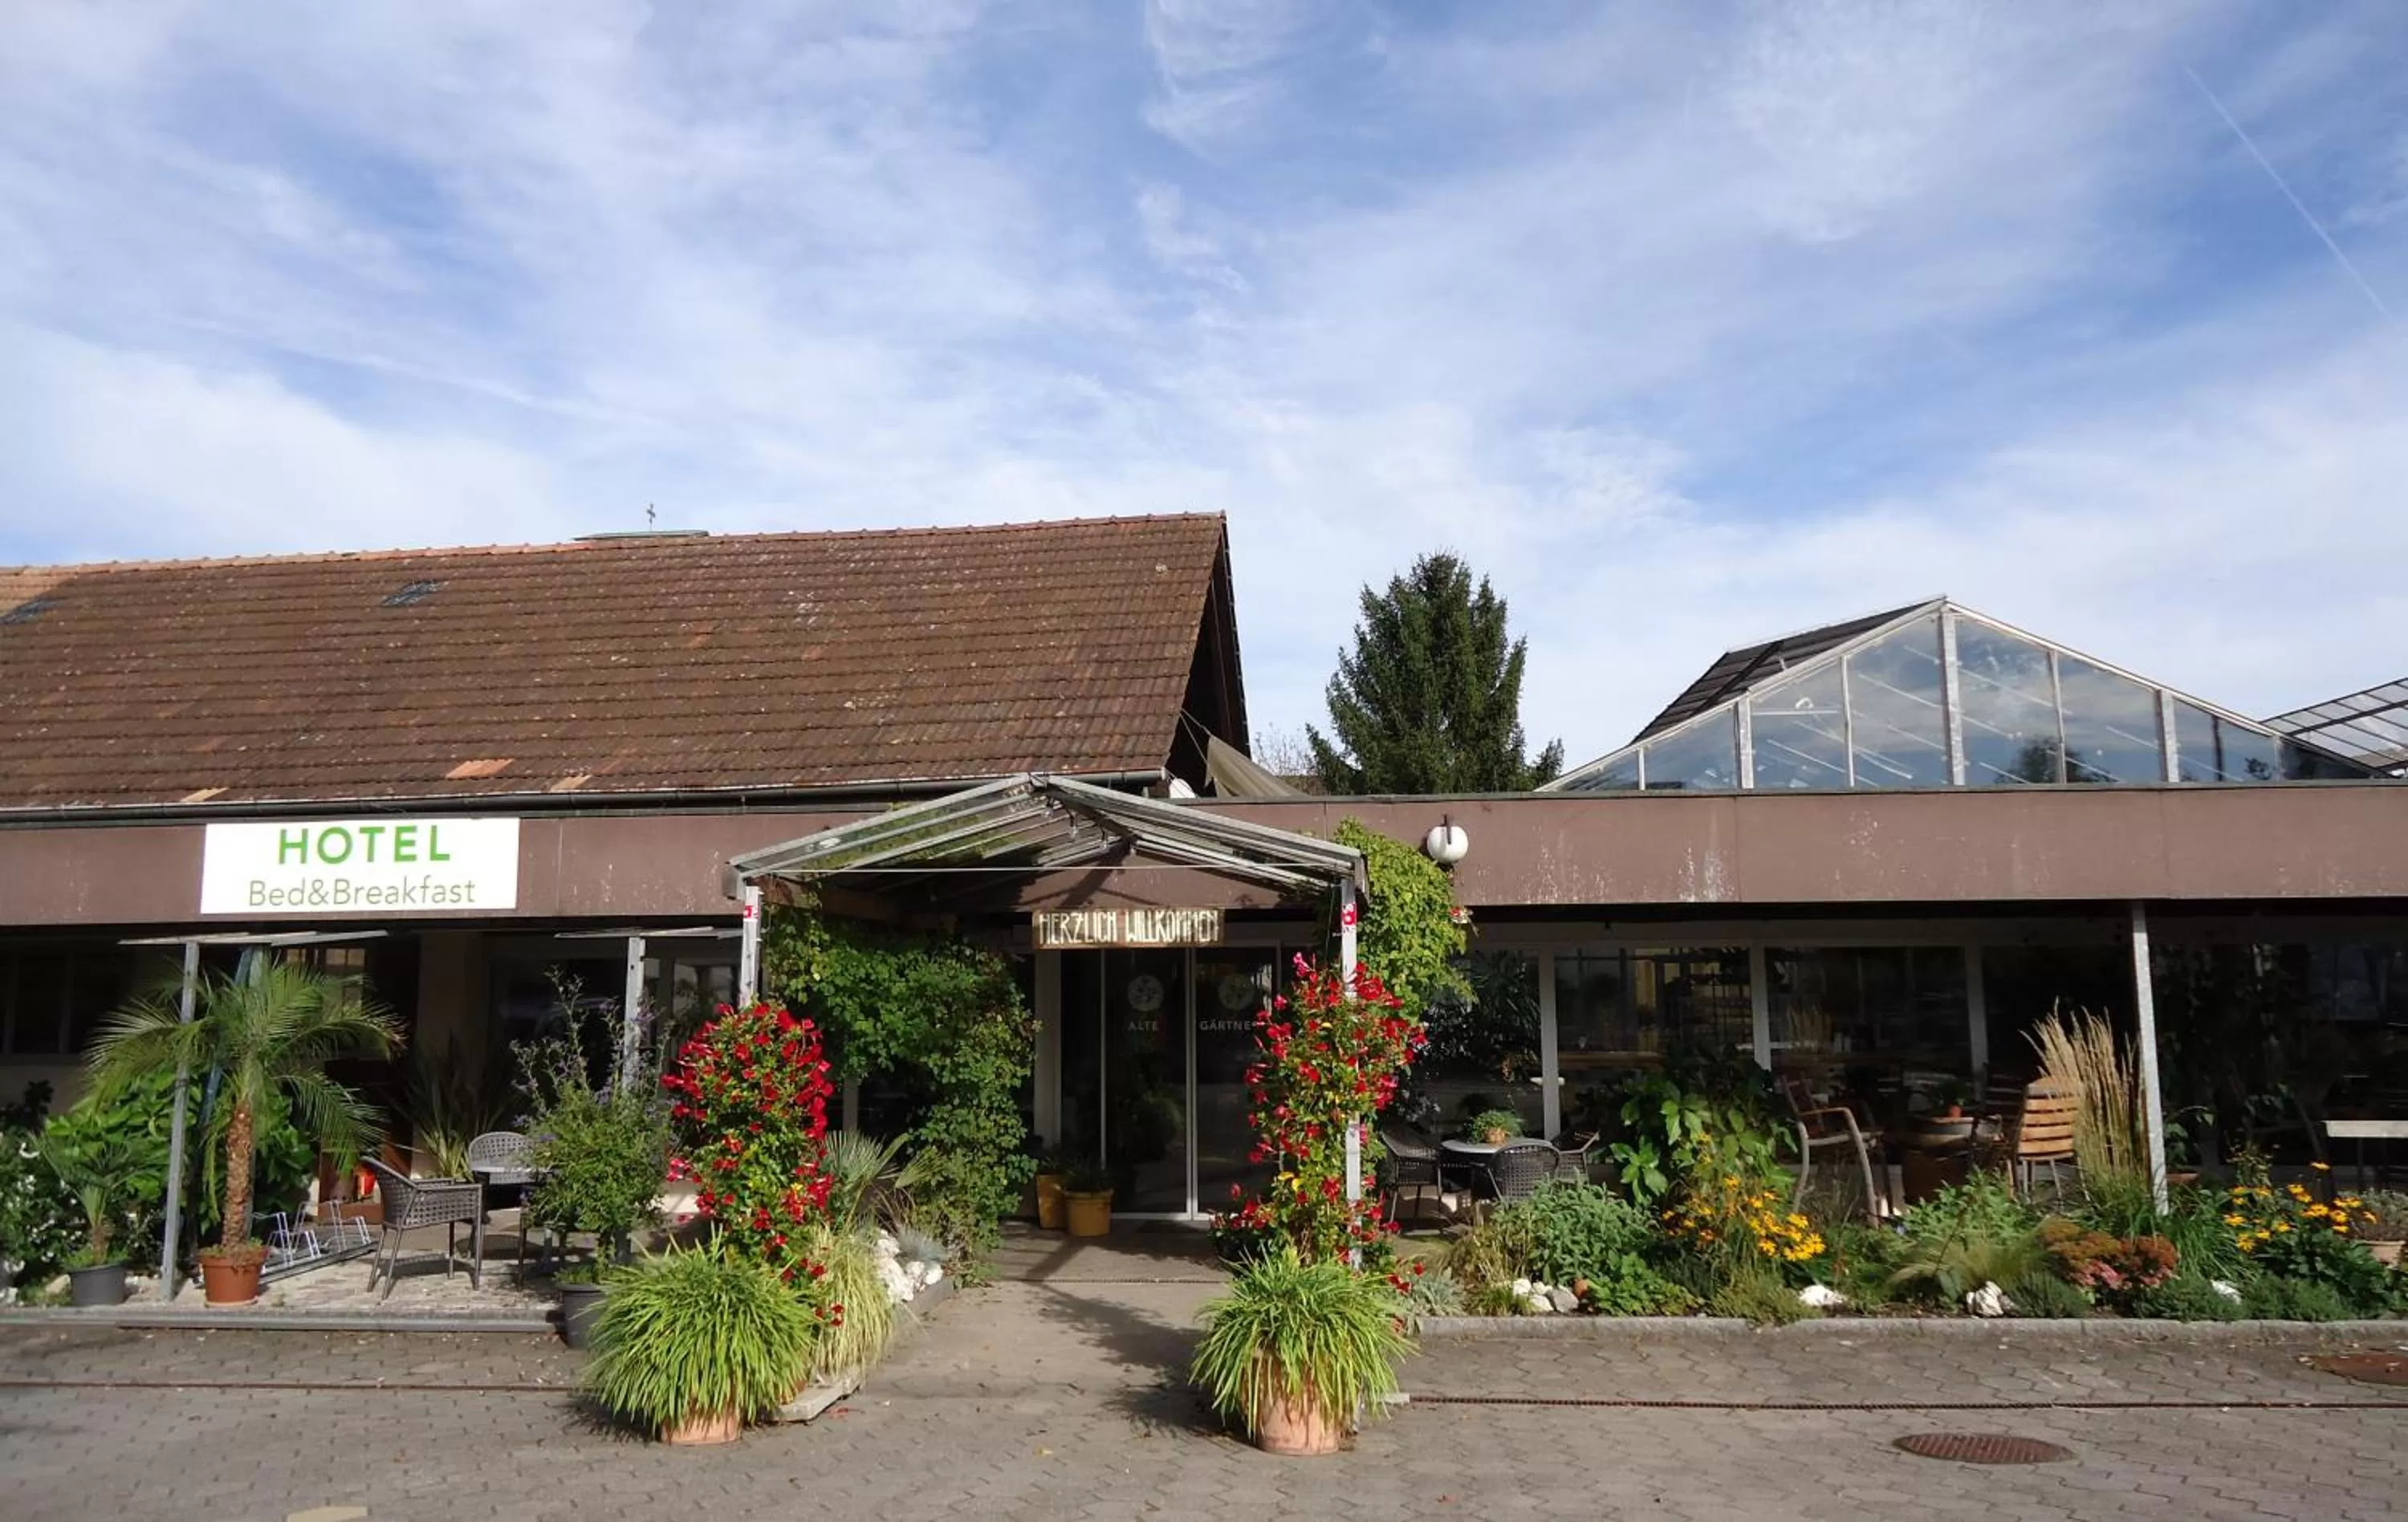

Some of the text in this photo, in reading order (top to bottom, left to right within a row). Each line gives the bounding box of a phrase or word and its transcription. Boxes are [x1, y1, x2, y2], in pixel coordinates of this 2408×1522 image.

[278, 824, 450, 865] HOTEL
[249, 876, 476, 907] Bed&Breakfast
[1039, 908, 1219, 945] HERZLICH WILLKOMMEN
[1128, 1017, 1252, 1032] ALTE GÄRTNE
